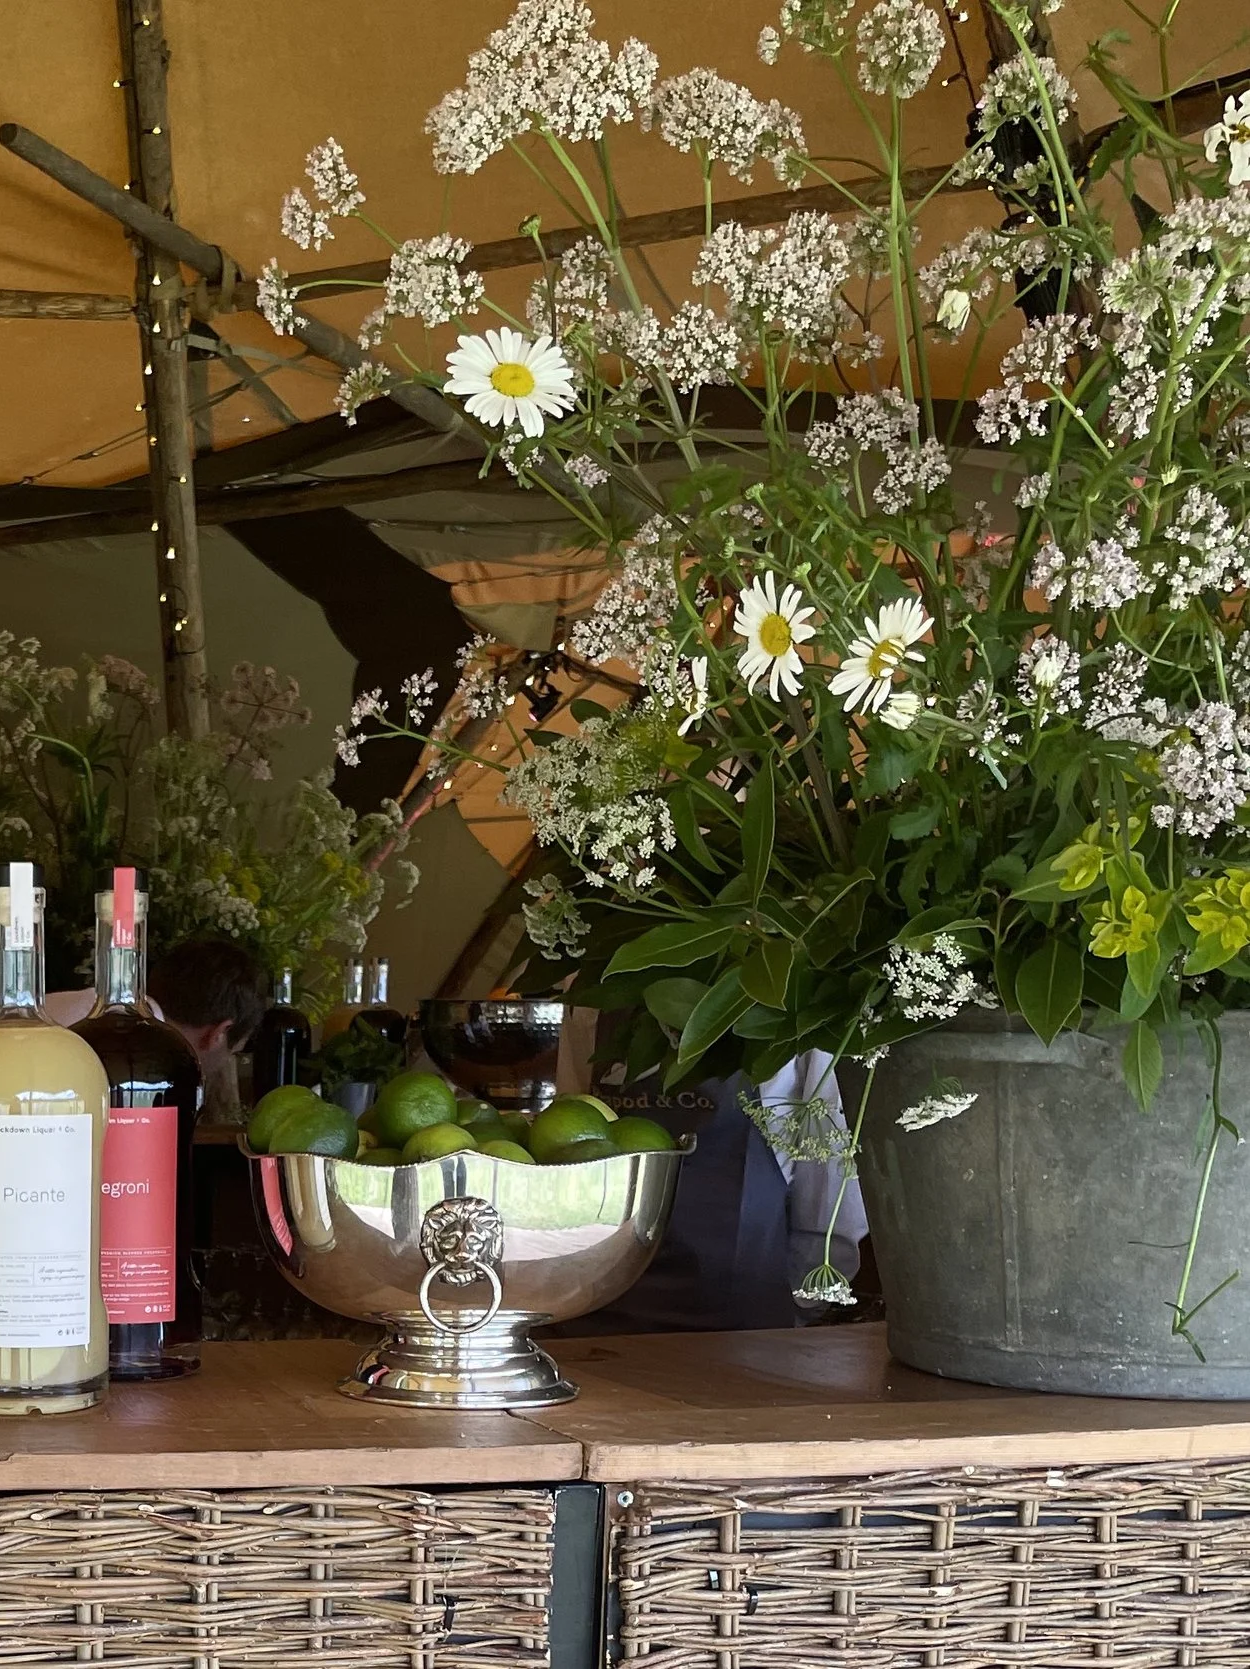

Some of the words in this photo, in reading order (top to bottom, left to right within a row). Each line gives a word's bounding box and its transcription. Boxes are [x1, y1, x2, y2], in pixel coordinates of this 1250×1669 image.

[655, 1094, 672, 1108] &
[677, 1091, 715, 1109] Co.
[3, 1187, 66, 1203] Picante
[101, 1178, 150, 1198] egroni
